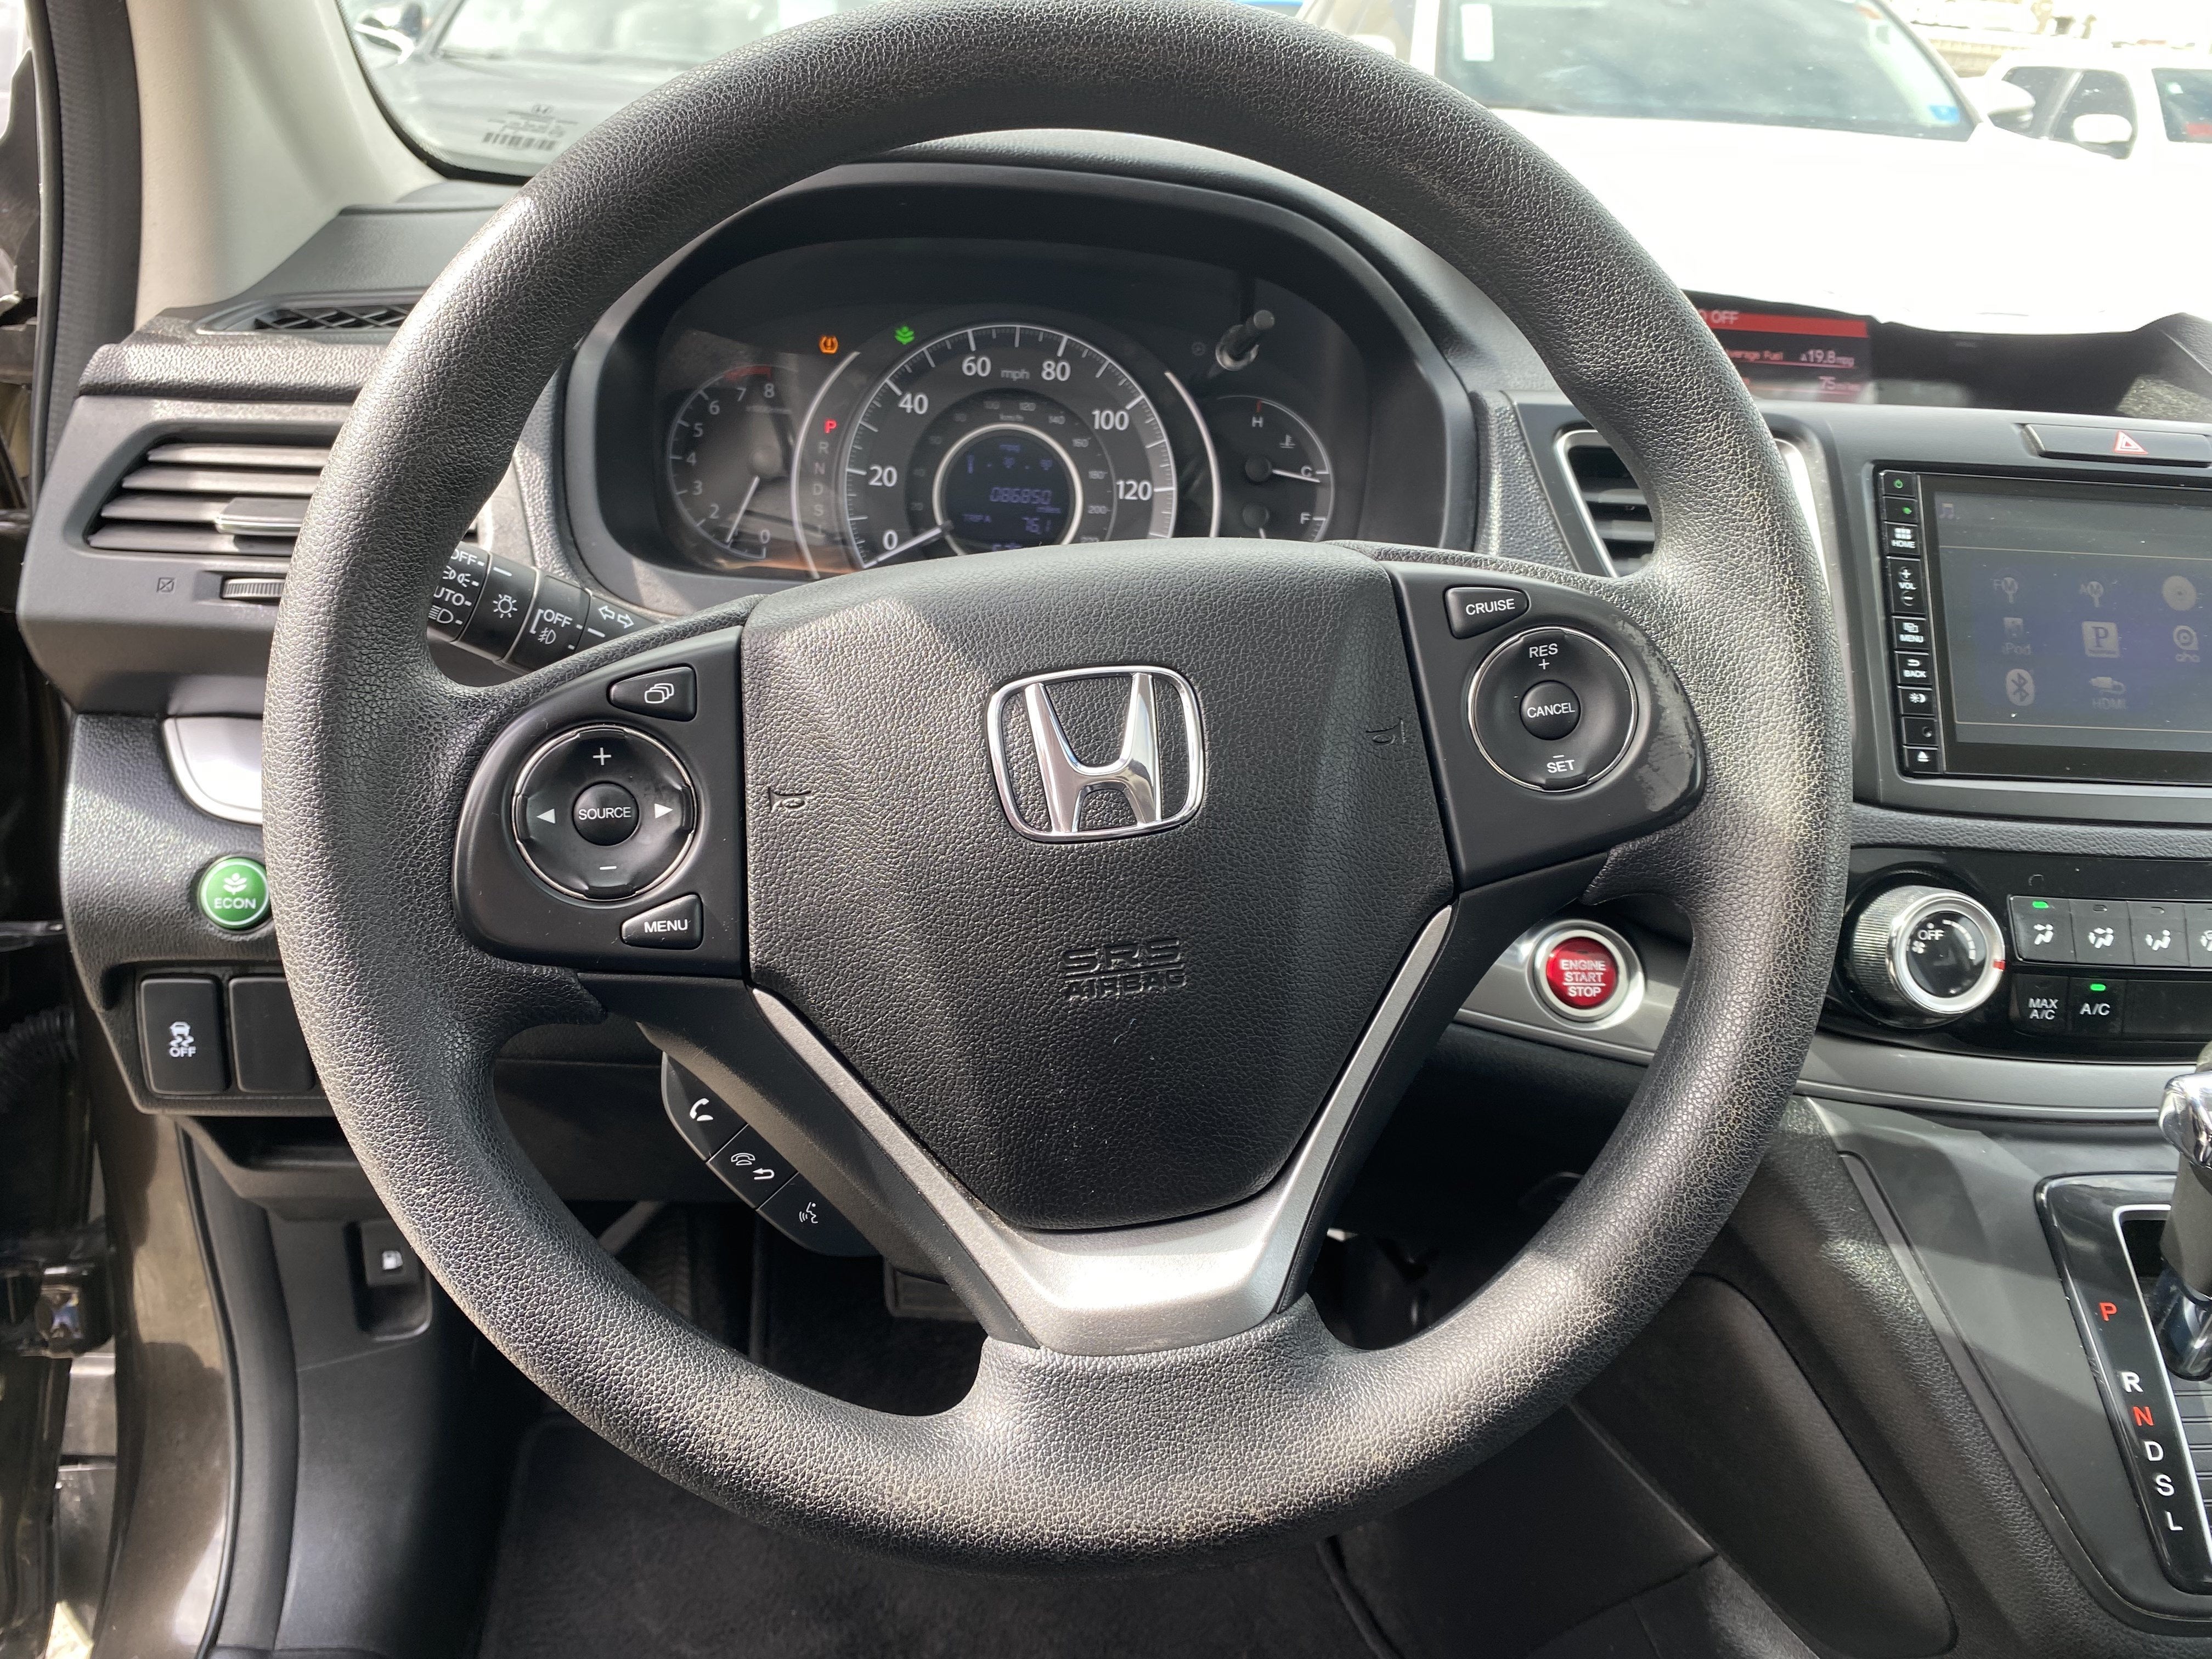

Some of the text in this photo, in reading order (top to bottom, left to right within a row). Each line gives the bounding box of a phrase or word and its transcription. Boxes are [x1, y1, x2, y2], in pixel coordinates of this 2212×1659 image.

[962, 356, 991, 377] 60
[1001, 367, 1030, 381] mph
[1042, 360, 1071, 382] 80
[709, 400, 720, 415] 6
[898, 393, 928, 415] 40
[825, 419, 837, 433] P
[1092, 409, 1130, 431] 100
[1252, 416, 1263, 428] H
[693, 422, 703, 437] 5
[686, 452, 697, 466] 4
[868, 466, 898, 487] 20
[1116, 479, 1153, 501] 120
[882, 529, 898, 550] 0
[1891, 539, 1916, 549] HOME
[1898, 581, 1917, 590] VOL
[433, 585, 465, 606] UTO
[1465, 598, 1515, 616] CRUISE
[543, 610, 572, 627] OFF
[1899, 634, 1924, 643] MENU
[1528, 643, 1559, 658] RES
[1903, 669, 1927, 678] BACK
[1526, 702, 1576, 719] CANCEL
[1547, 759, 1576, 774] SET
[578, 806, 631, 821] SOURCE
[213, 898, 257, 910] ECON
[644, 919, 689, 934] MENU
[1917, 929, 1945, 940] OFF
[1062, 938, 1183, 977] SRS
[1559, 960, 1607, 971] ENGINE
[1564, 972, 1604, 983] START
[1063, 969, 1188, 1002] AIRBAG
[1567, 986, 1601, 997] STOP
[2029, 998, 2058, 1009] MAX
[2080, 1002, 2111, 1016] A/C
[2030, 1009, 2056, 1020] A/C
[168, 1046, 196, 1058] OFF
[2099, 1302, 2118, 1322] P
[2120, 1372, 2143, 1393] R
[2132, 1406, 2154, 1426] N
[2144, 1440, 2164, 1462] D
[2155, 1474, 2175, 1497] S
[2166, 1510, 2183, 1531] L
